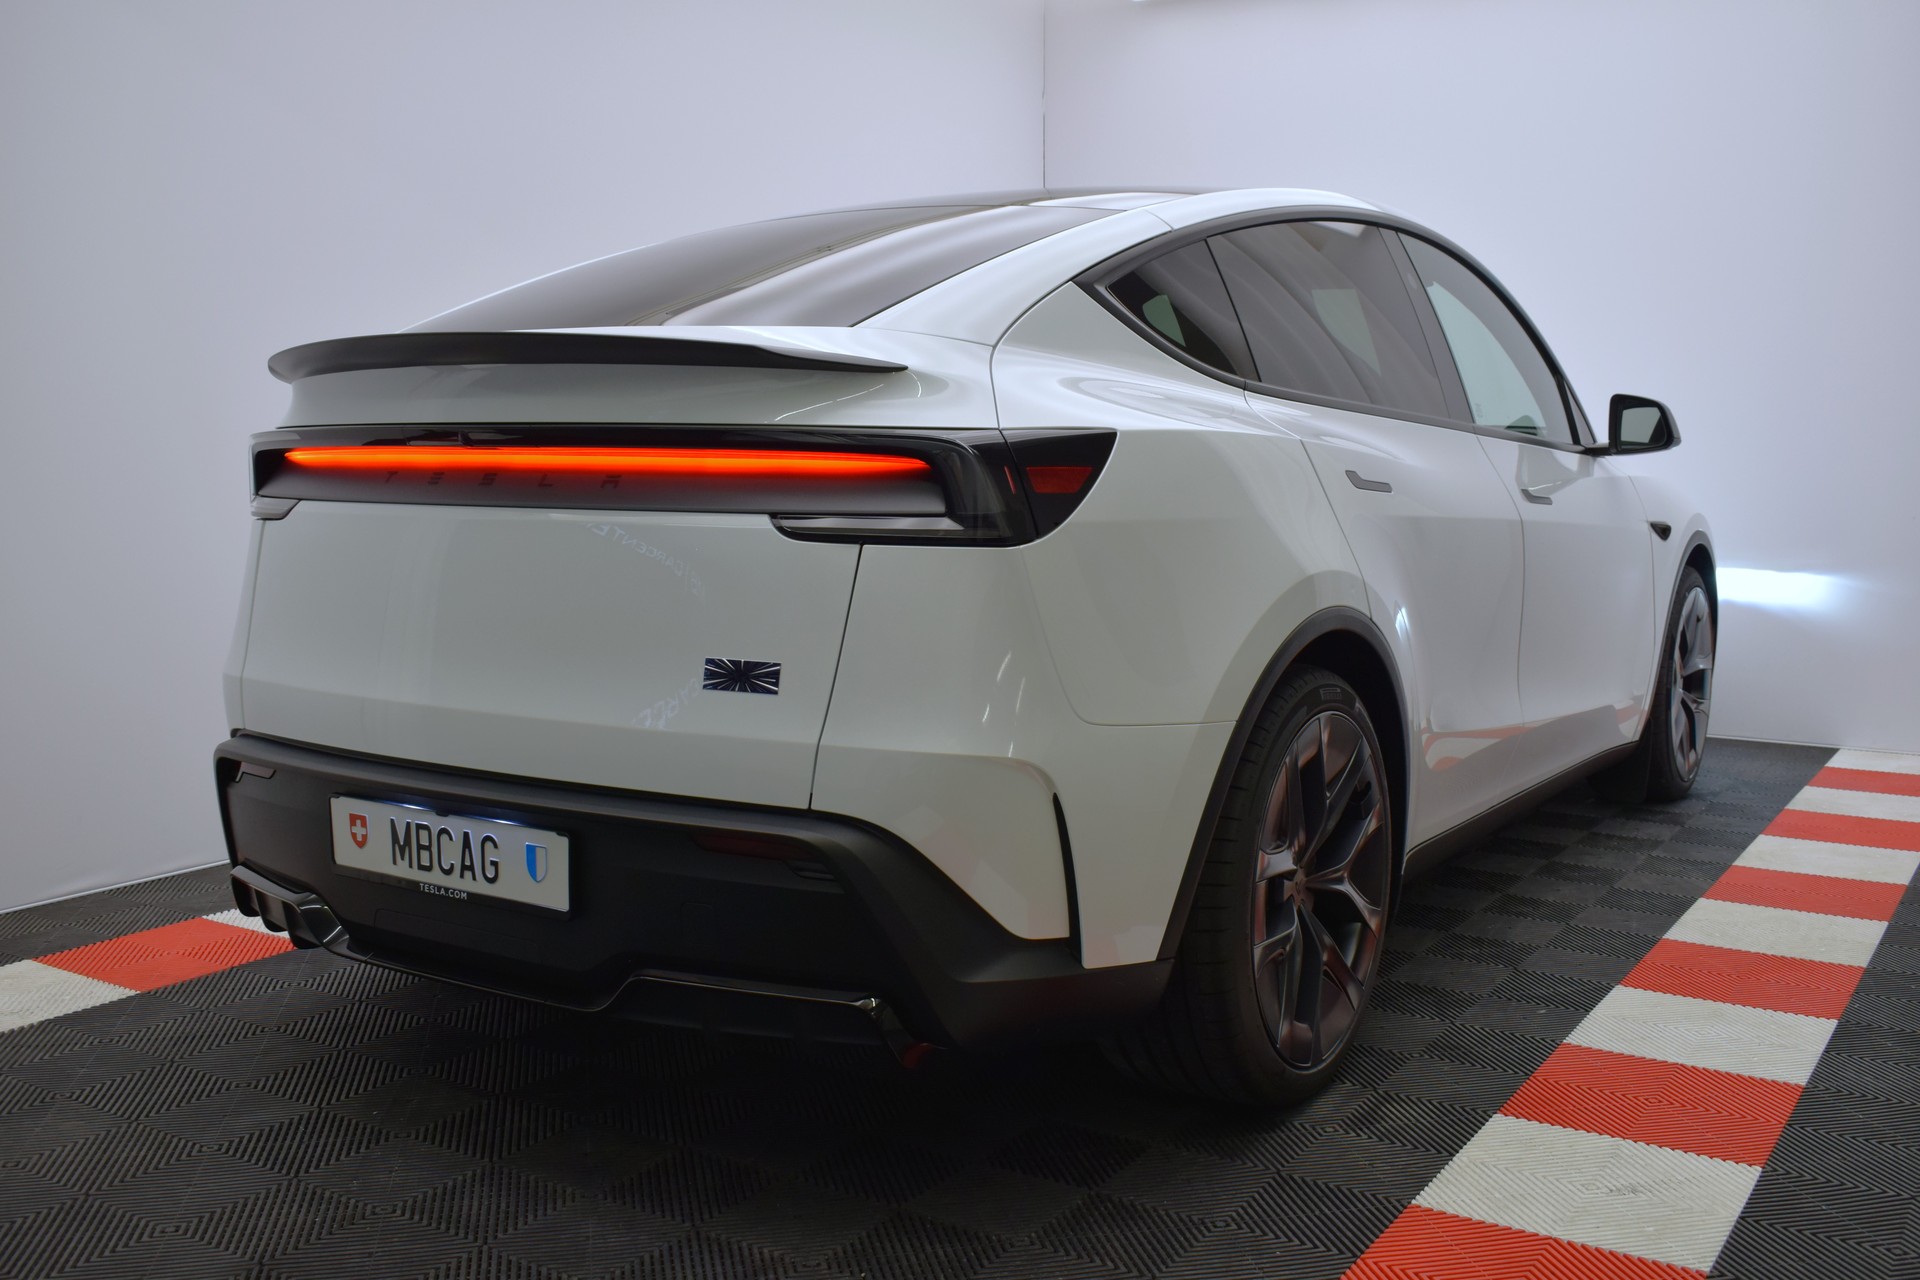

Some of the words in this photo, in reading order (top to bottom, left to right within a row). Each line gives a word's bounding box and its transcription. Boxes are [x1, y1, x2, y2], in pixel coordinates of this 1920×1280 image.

[385, 471, 622, 489] TESLA
[390, 816, 499, 884] MBCAG
[419, 882, 468, 900] TESLA.COM
